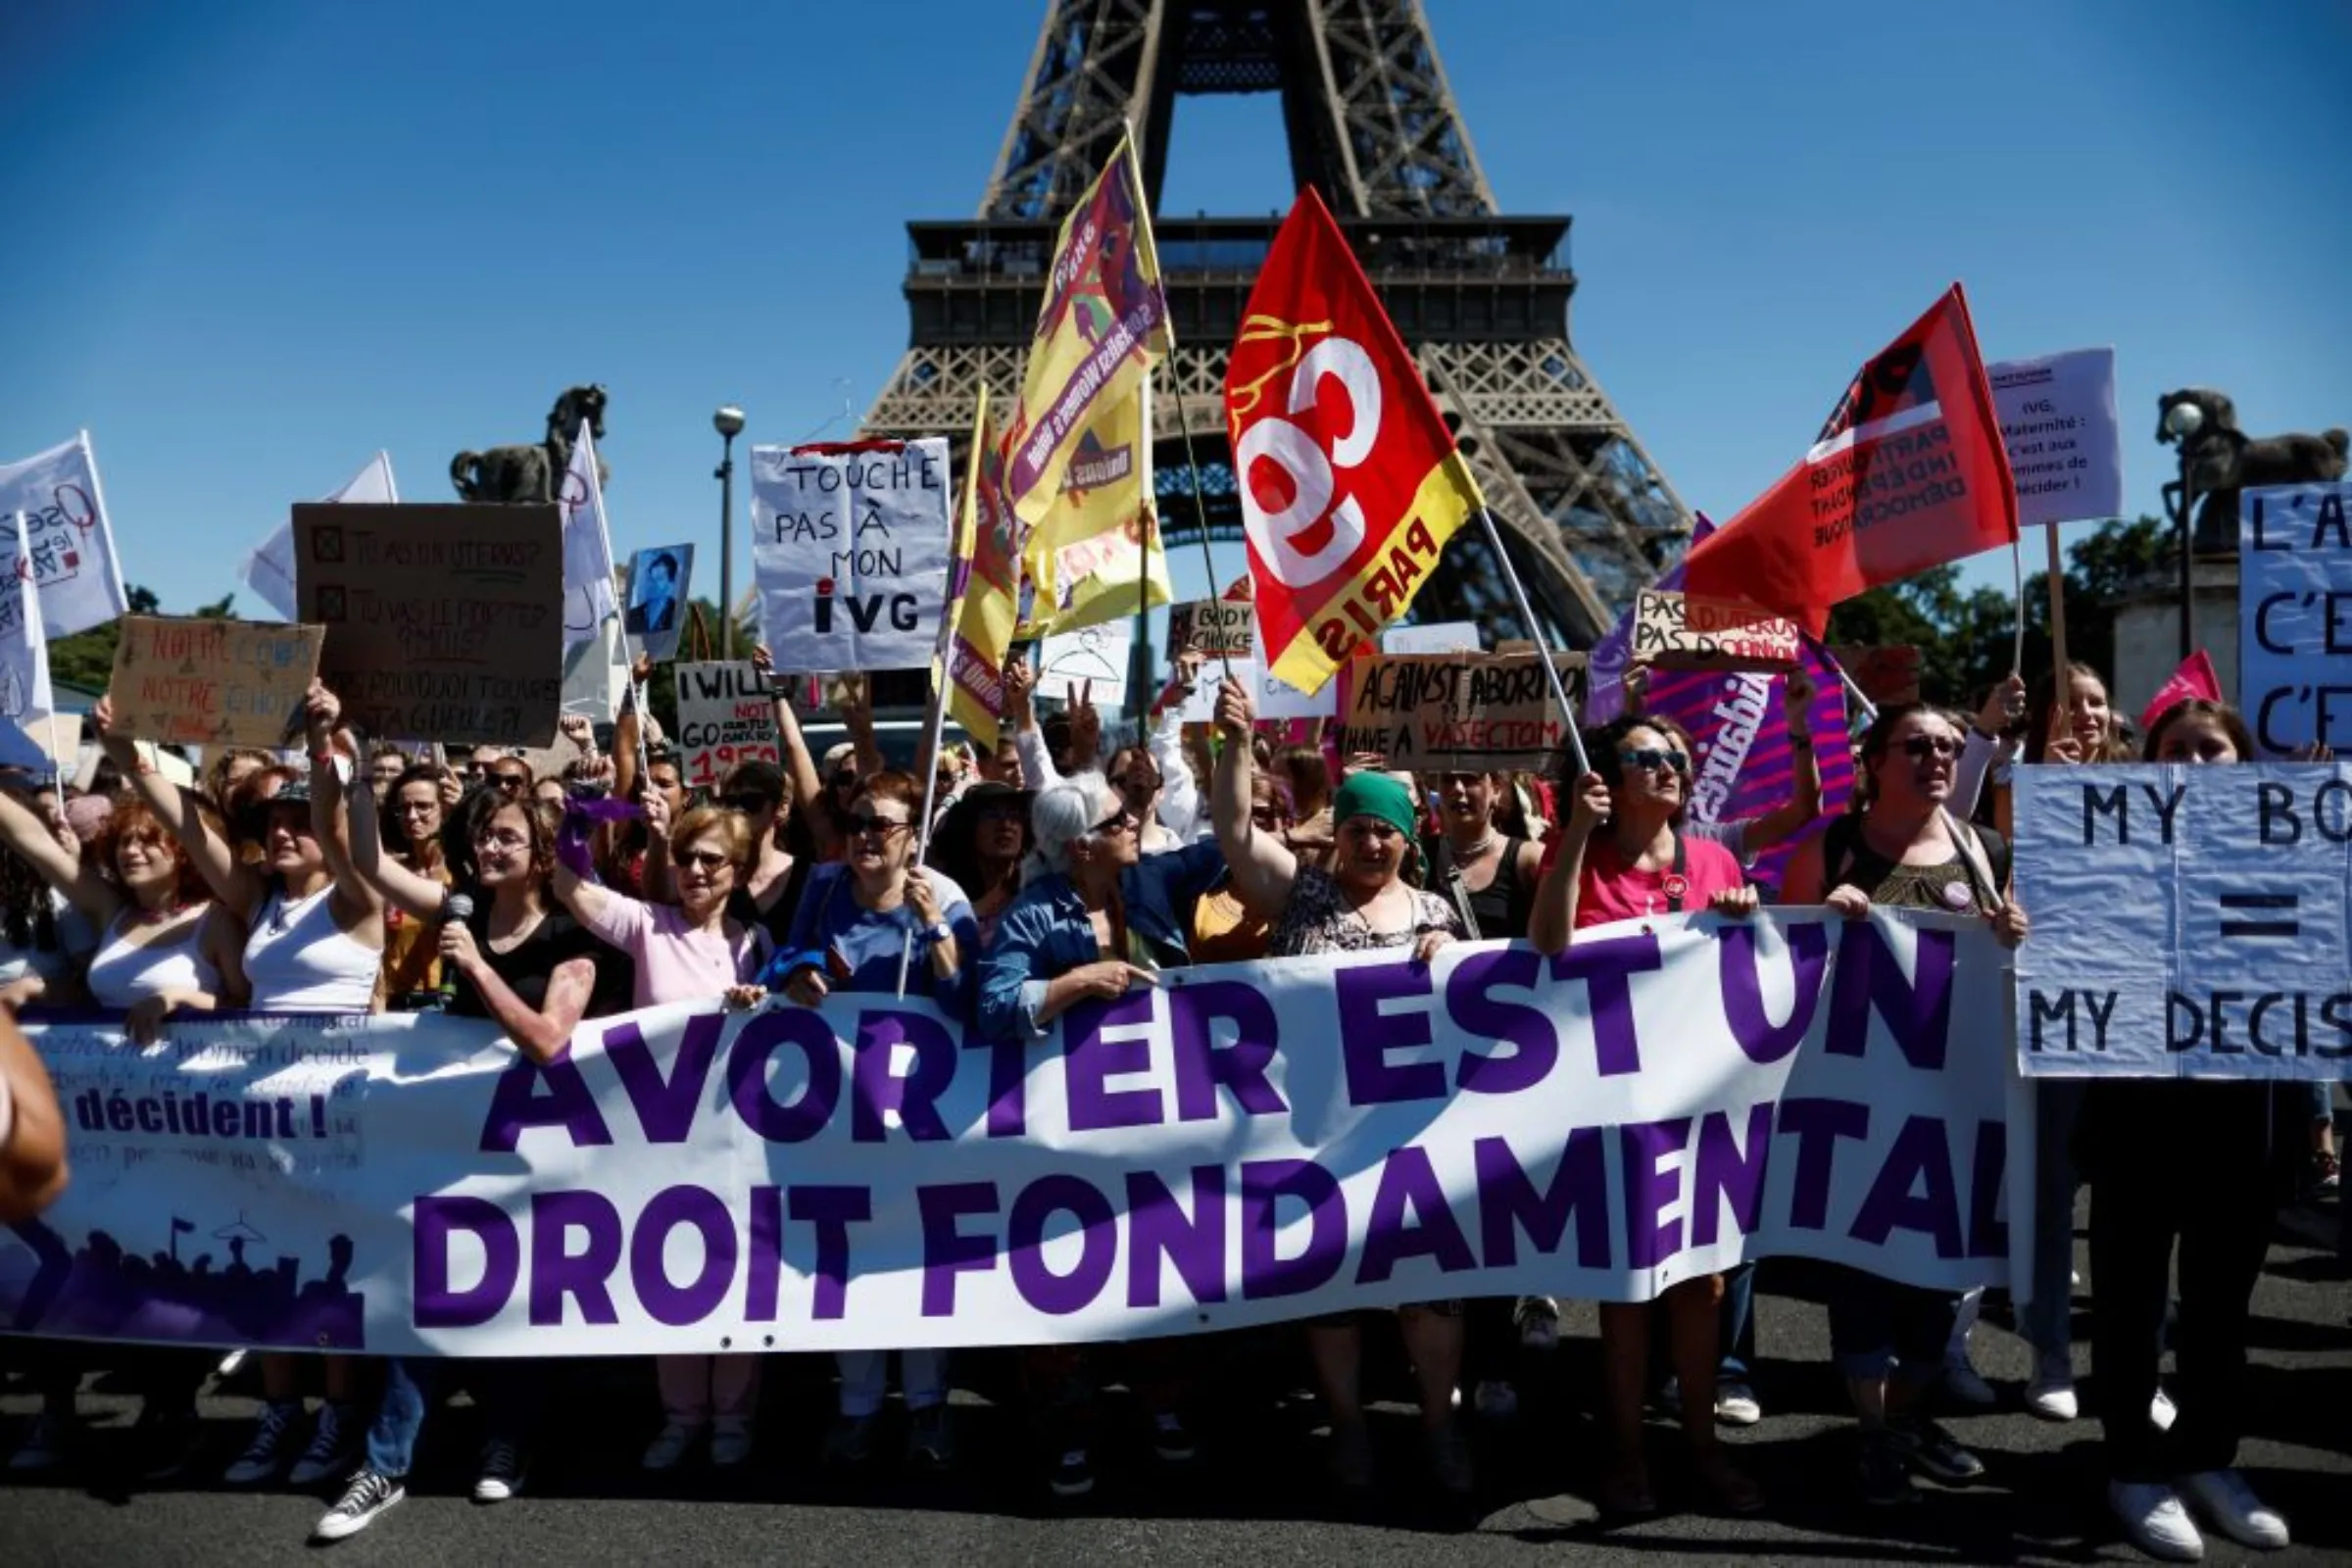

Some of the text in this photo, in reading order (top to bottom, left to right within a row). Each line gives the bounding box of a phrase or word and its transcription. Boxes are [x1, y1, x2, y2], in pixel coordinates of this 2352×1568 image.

[787, 457, 941, 492] TOUCHE
[775, 498, 890, 543] PAS À
[831, 550, 902, 578] MON
[1199, 608, 1251, 626] BODY
[679, 667, 774, 701] I WILL
[1356, 662, 1464, 713] AGAINST
[682, 721, 720, 748] GO
[1395, 722, 1412, 760] A
[2083, 783, 2185, 847] MY
[479, 920, 1955, 1152] AVORTER EST UN
[2029, 988, 2119, 1053] MY
[75, 1087, 327, 1139] décident !
[413, 1098, 2007, 1328] DROIT FONDAMENTAL
